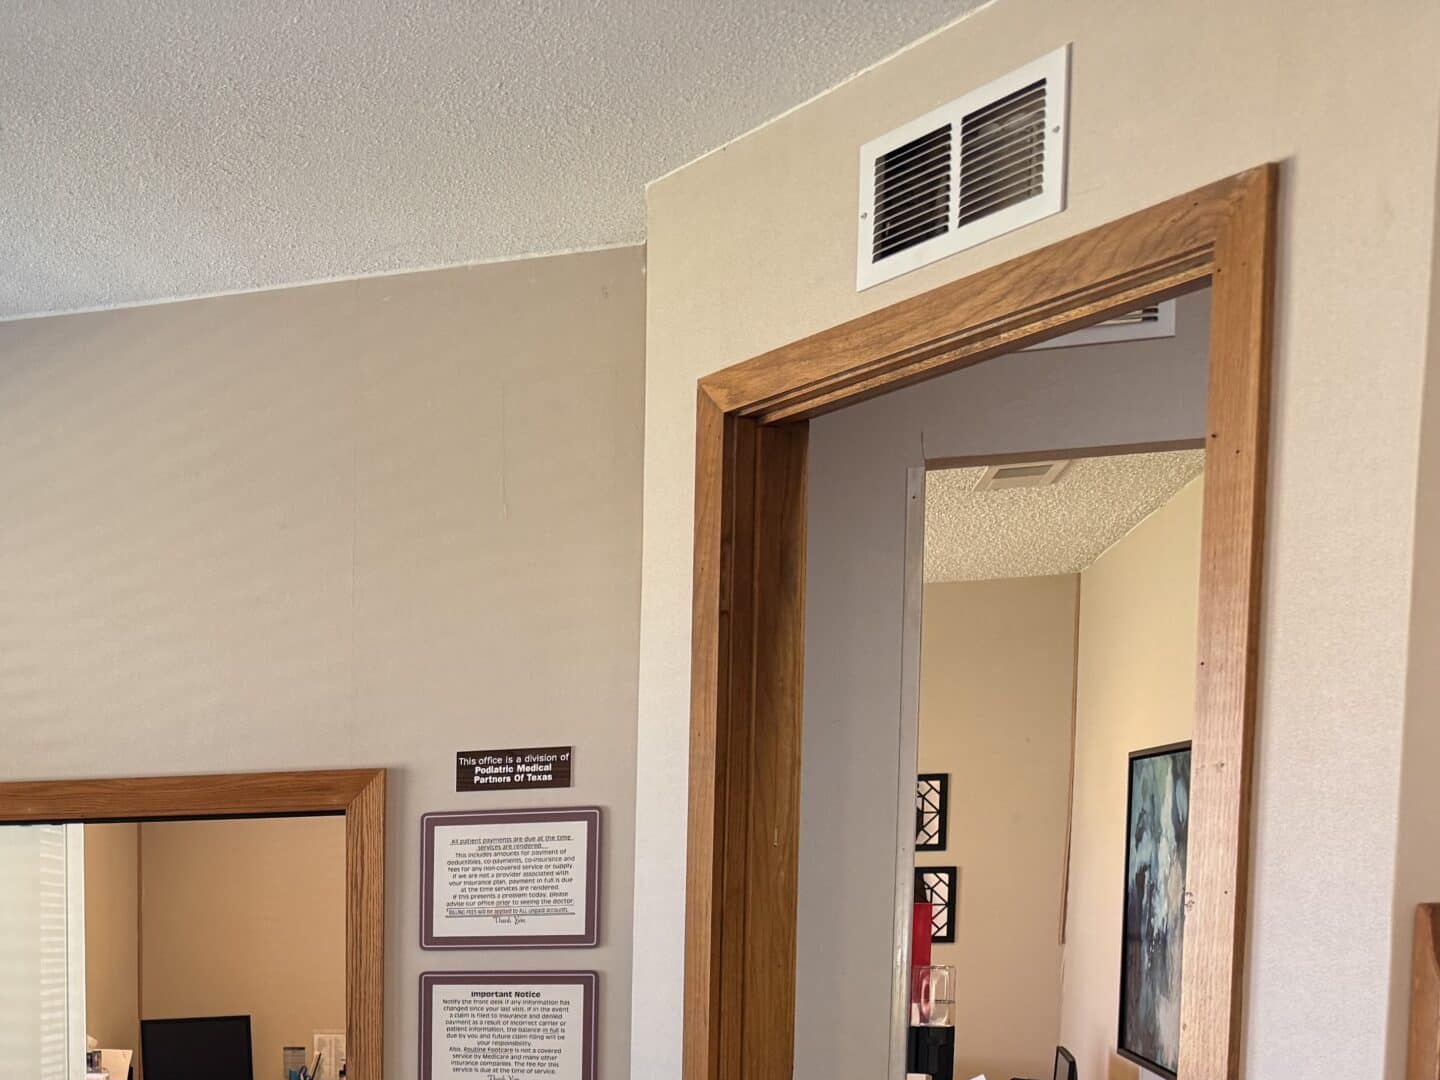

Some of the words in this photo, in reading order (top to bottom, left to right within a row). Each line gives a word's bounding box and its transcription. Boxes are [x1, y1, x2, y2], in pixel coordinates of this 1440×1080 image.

[459, 757, 476, 766] This
[478, 756, 502, 765] office
[506, 755, 512, 764] is
[525, 754, 557, 762] division
[475, 765, 513, 774] Podiatric
[517, 764, 552, 772] Medical
[474, 775, 511, 784] Partners
[471, 991, 512, 999] Important
